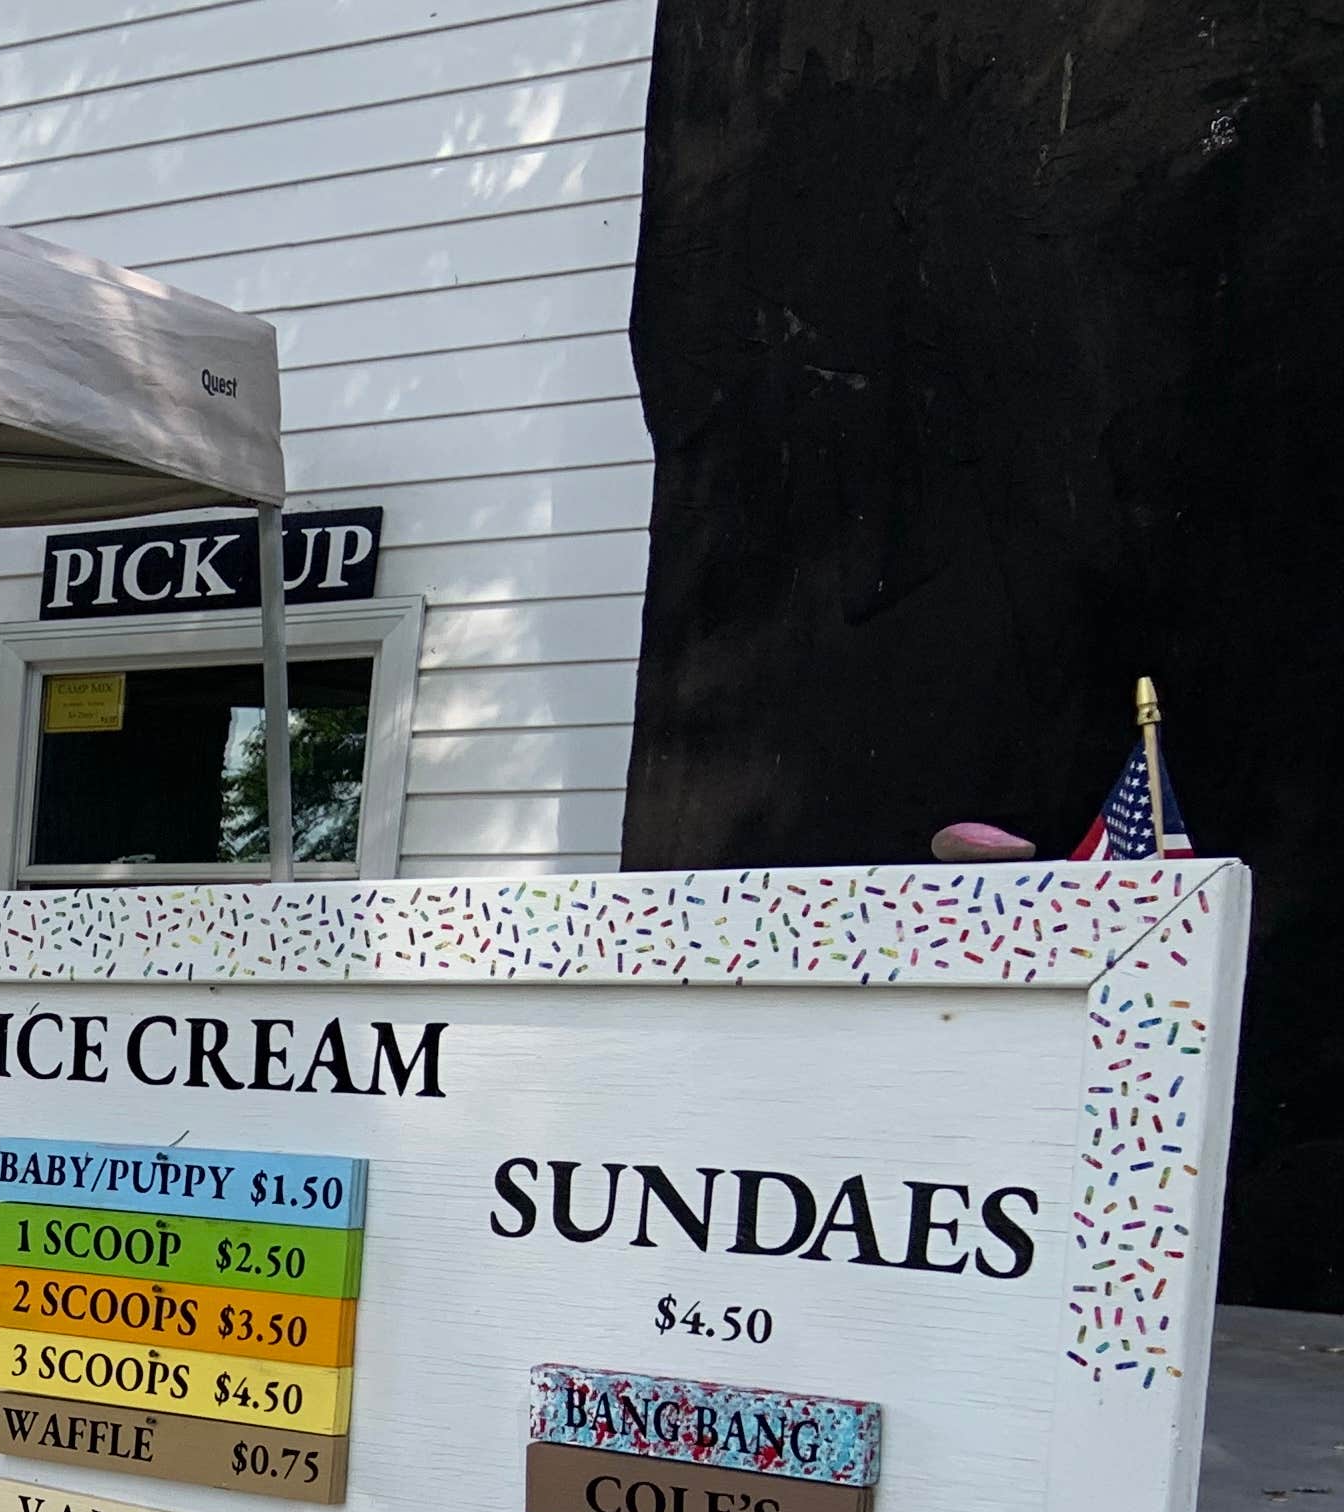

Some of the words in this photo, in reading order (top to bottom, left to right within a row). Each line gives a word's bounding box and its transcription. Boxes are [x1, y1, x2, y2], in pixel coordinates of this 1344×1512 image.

[201, 369, 238, 398] Quest
[46, 534, 241, 608] PICK
[127, 1015, 449, 1099] CREAM
[250, 1169, 343, 1210] $1.50
[16, 1219, 32, 1252] 1
[43, 1219, 181, 1268] SCOOP
[489, 1156, 1039, 1280] SUNDAES
[215, 1238, 305, 1279] $2.50
[12, 1279, 31, 1314] 2
[40, 1281, 199, 1337] SCOOPS
[218, 1304, 308, 1348] $3.50
[655, 1293, 773, 1345] $4.50
[11, 1343, 27, 1377] 3
[38, 1345, 190, 1400] SCOOPS
[214, 1371, 303, 1415] $4.50
[3, 1407, 154, 1462] WAFFLE
[565, 1386, 681, 1444] BANG
[697, 1405, 820, 1463] BANG
[231, 1440, 319, 1484] $0.75
